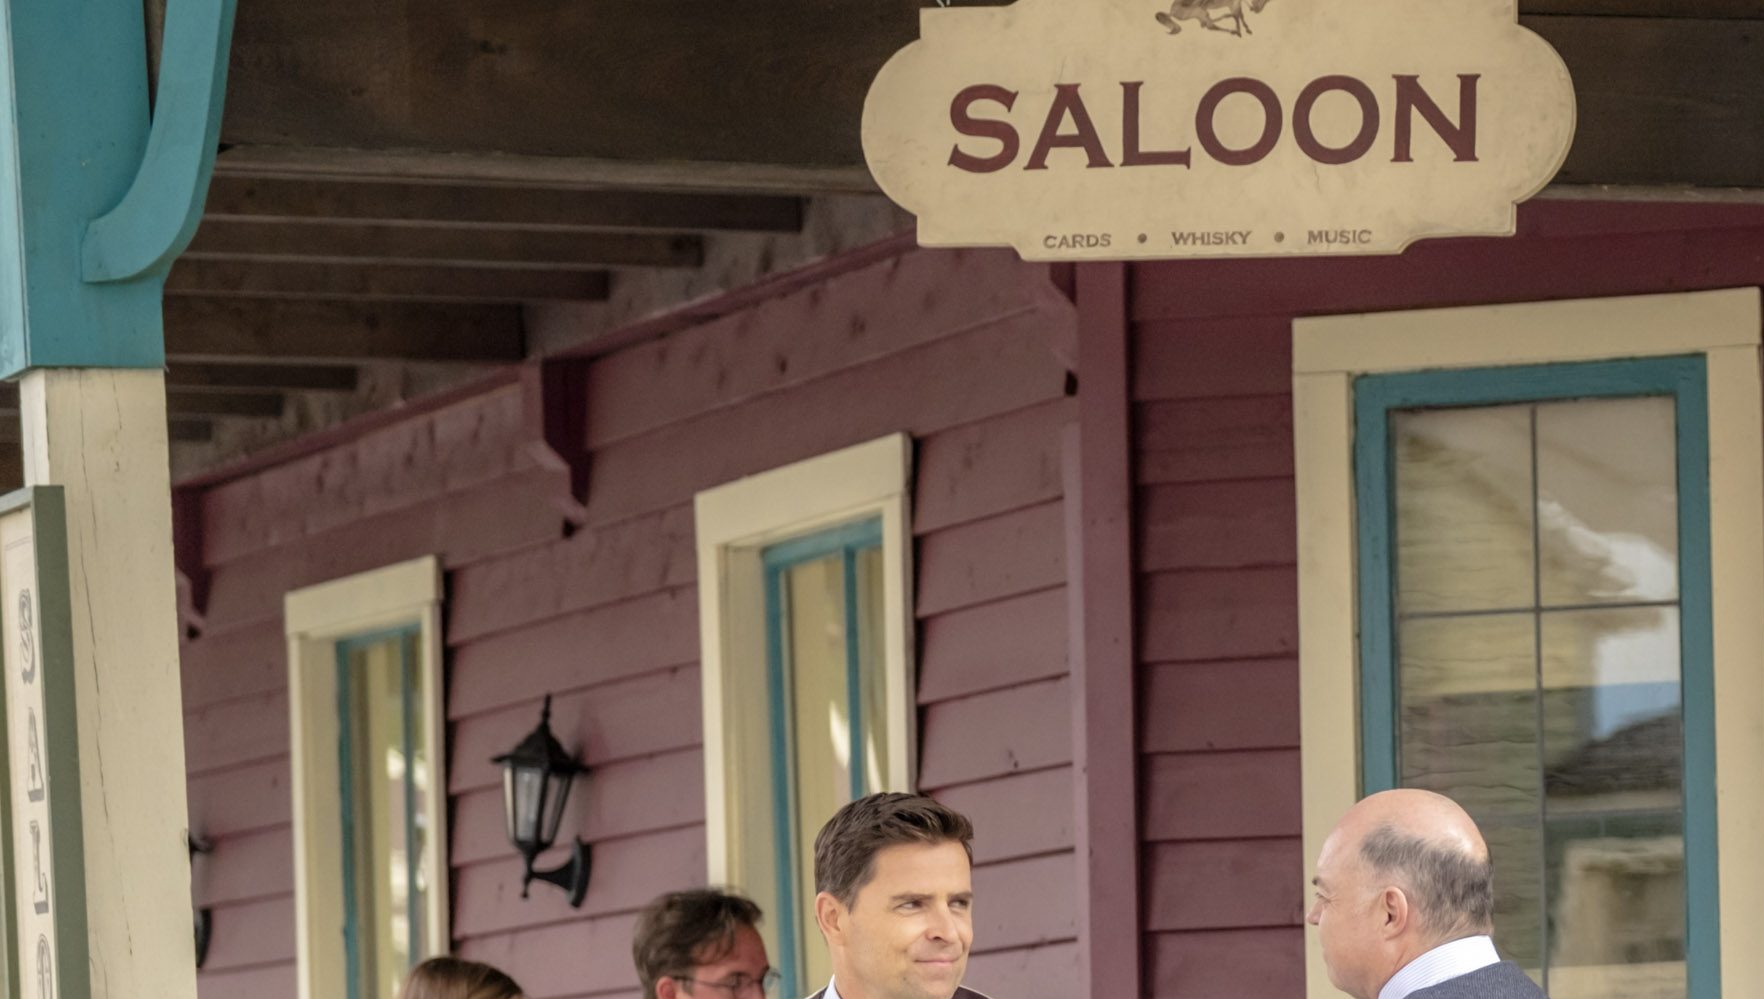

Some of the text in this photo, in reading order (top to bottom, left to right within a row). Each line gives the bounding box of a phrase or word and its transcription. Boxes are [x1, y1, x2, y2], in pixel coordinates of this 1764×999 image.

[947, 73, 1482, 174] SALOON
[1043, 229, 1373, 249] CARDS WHISKY MUSIC
